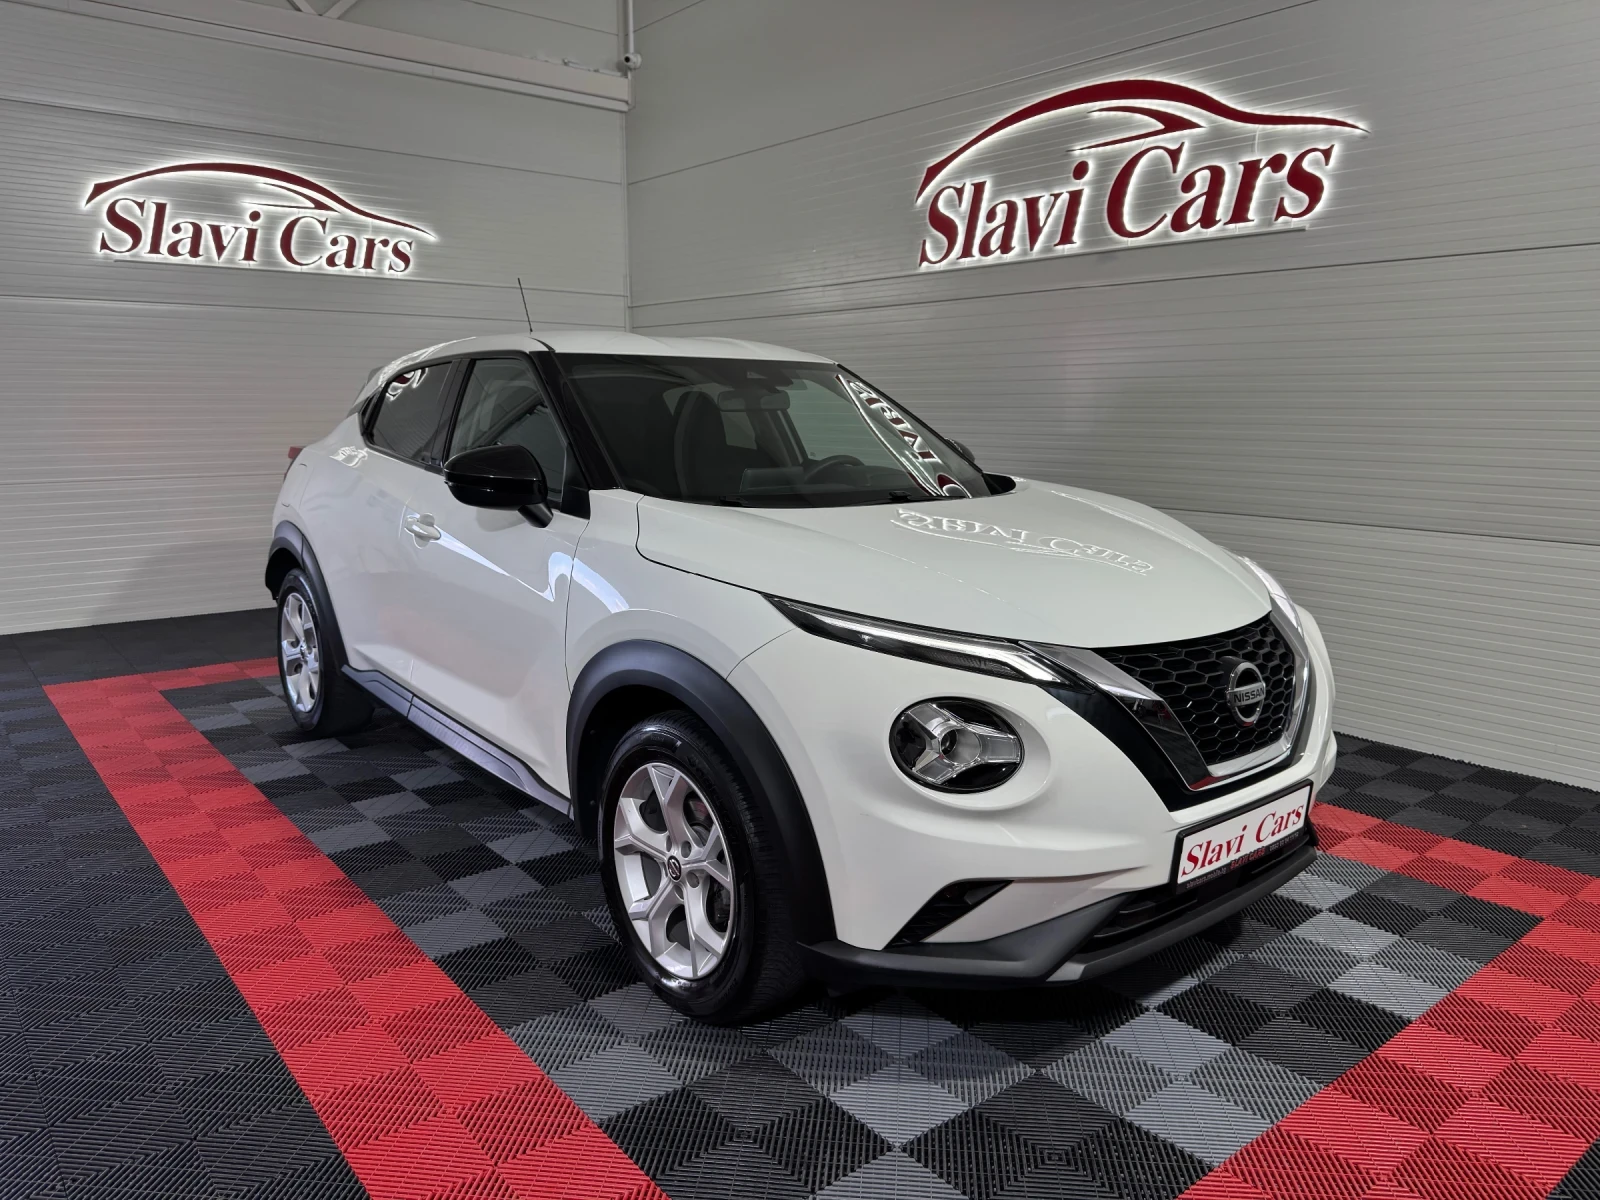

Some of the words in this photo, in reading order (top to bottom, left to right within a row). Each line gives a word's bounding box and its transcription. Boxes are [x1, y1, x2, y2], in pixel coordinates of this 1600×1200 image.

[99, 197, 261, 263] Slavi
[279, 215, 414, 273] Cars
[918, 160, 1090, 267] Slavi
[1106, 142, 1335, 239] Cars
[1233, 687, 1265, 704] NISSAN
[1181, 824, 1248, 878] Slavi
[1255, 804, 1305, 843] Cars
